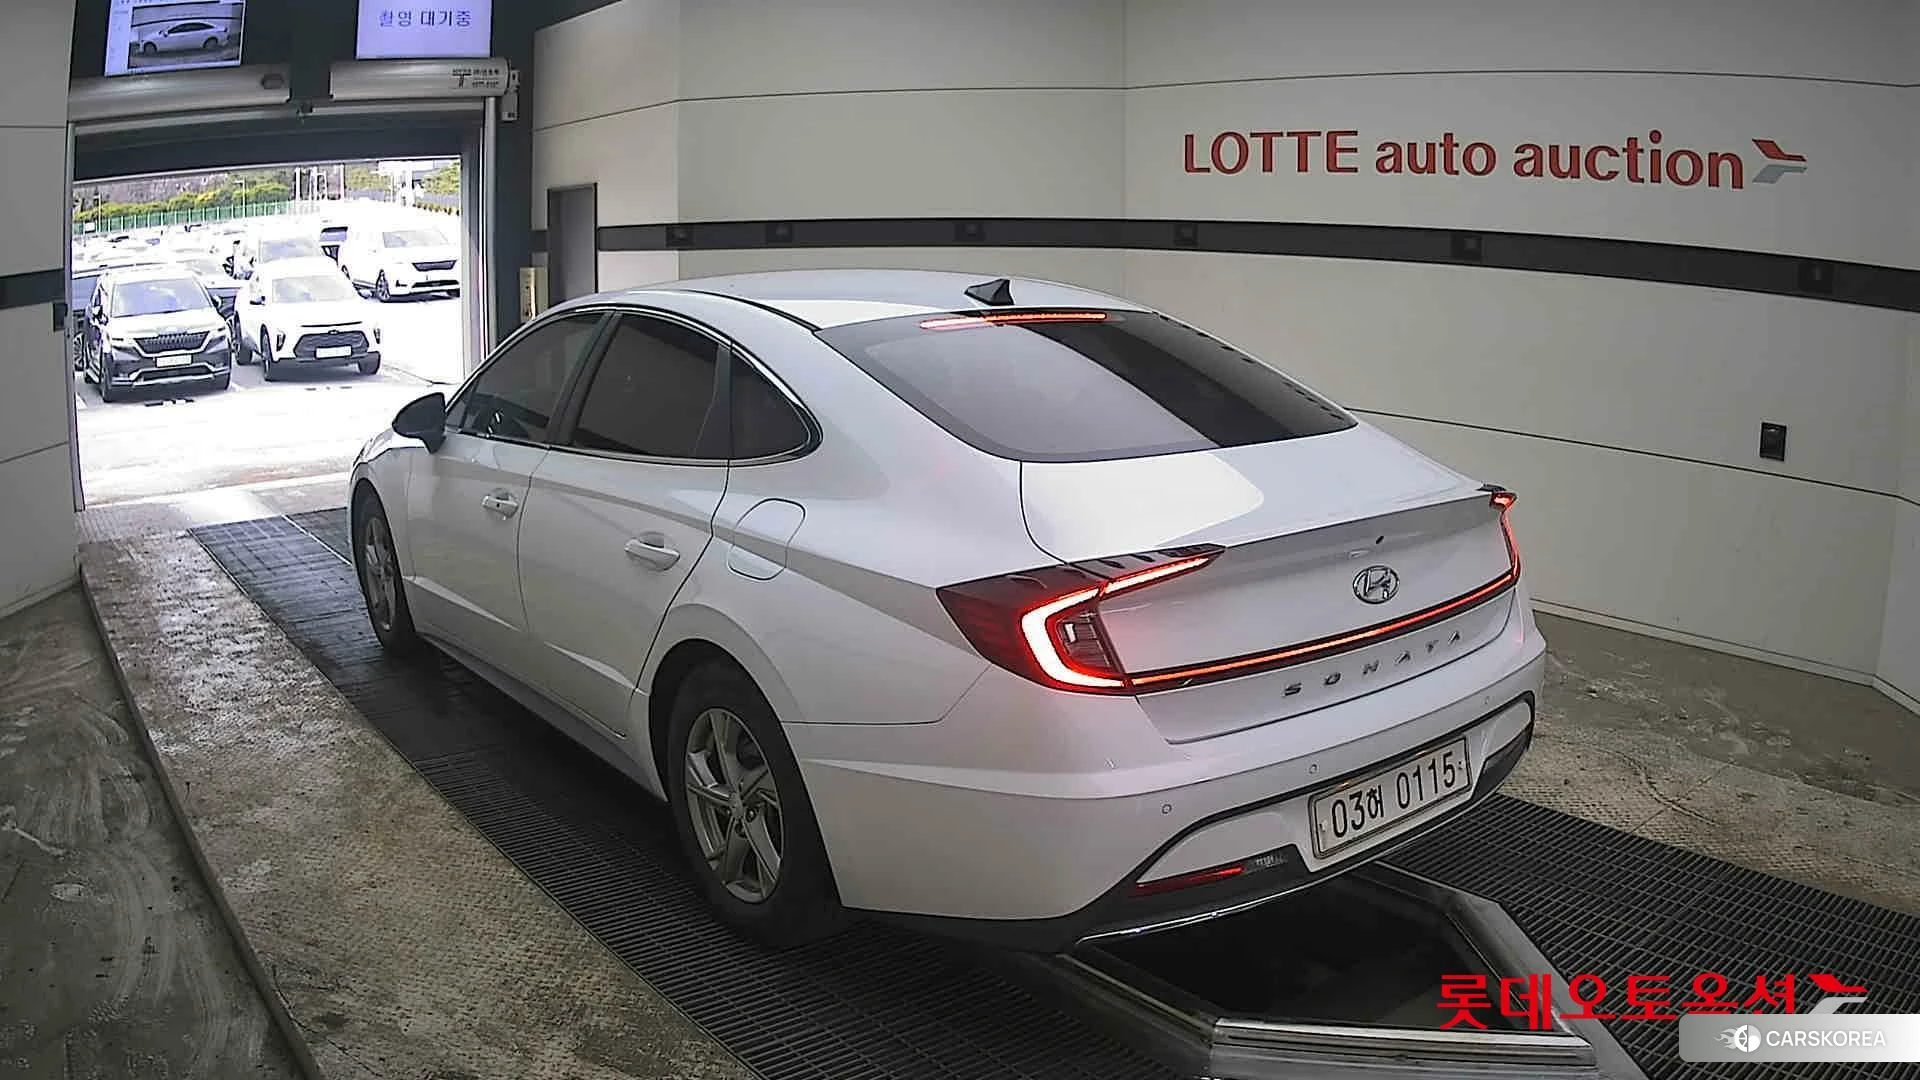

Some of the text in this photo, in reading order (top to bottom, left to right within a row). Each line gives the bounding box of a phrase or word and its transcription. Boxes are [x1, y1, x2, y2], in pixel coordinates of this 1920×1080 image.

[420, 10, 471, 27] 대기중
[1184, 130, 1744, 189] LOTTE auto auction
[1283, 630, 1462, 697] SONATA
[1331, 751, 1456, 838] 03허 0115
